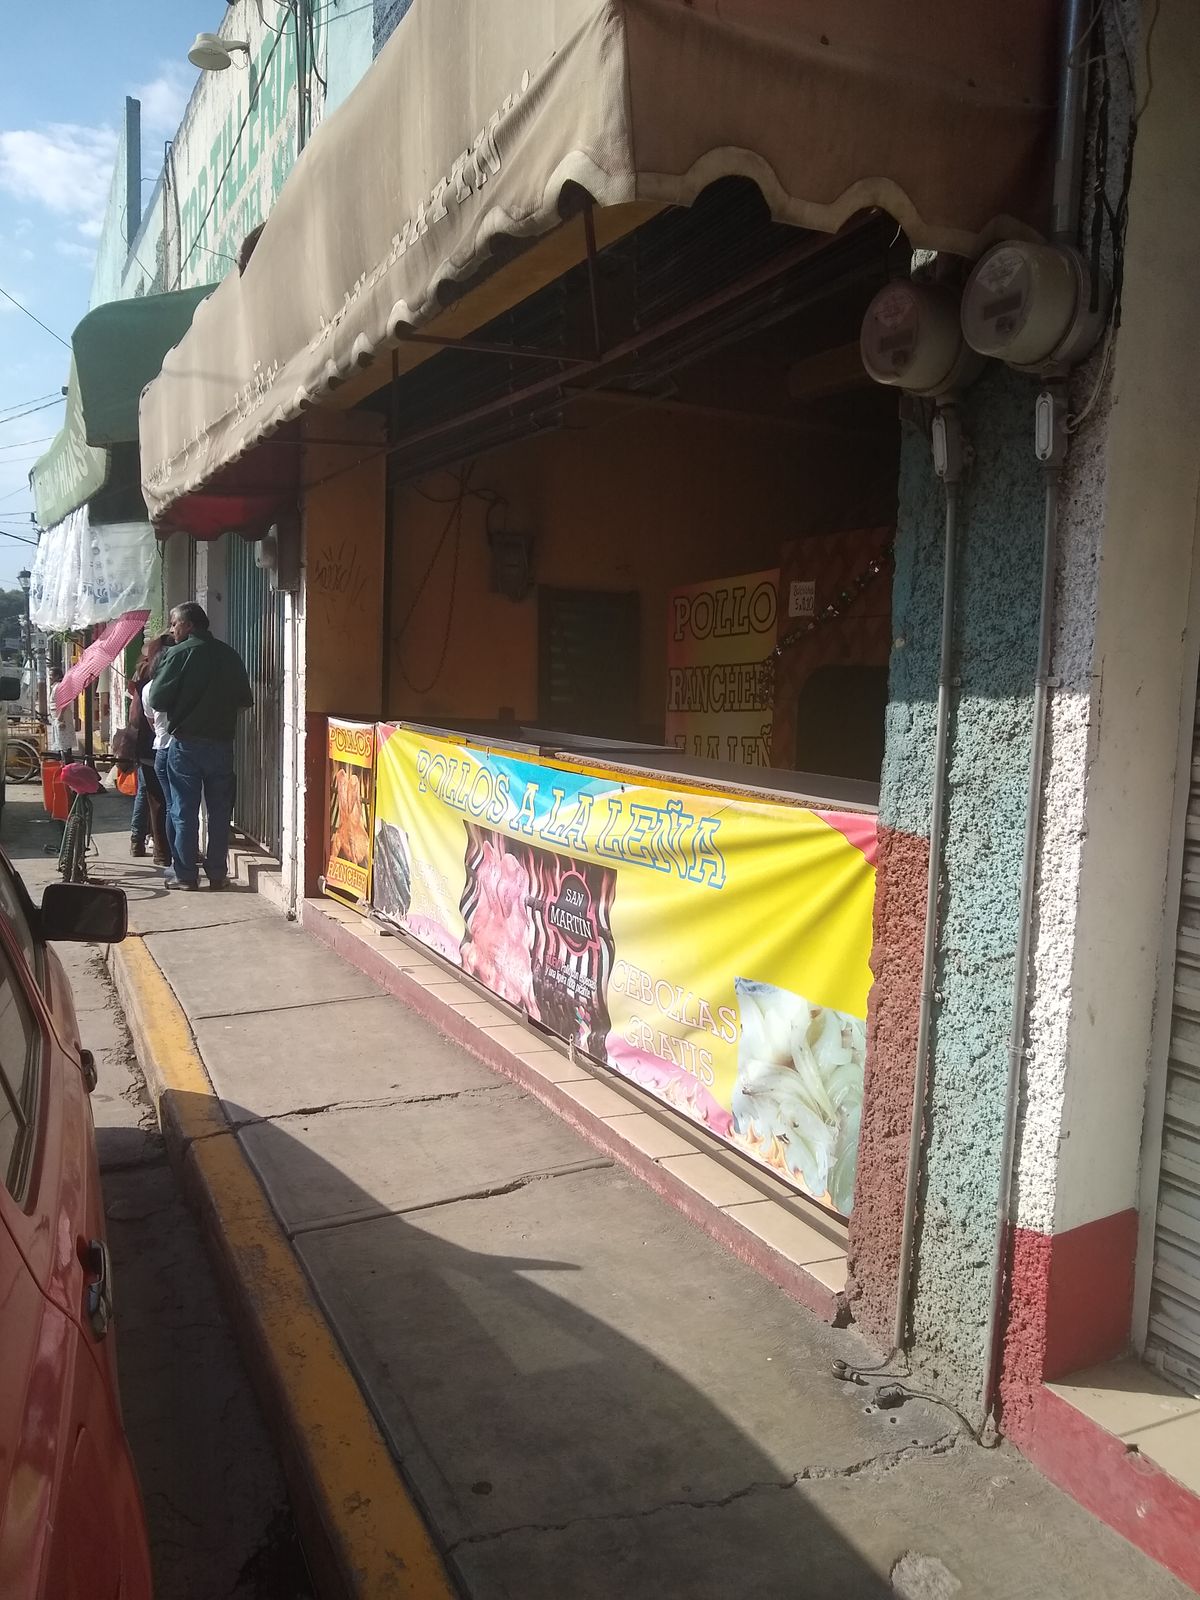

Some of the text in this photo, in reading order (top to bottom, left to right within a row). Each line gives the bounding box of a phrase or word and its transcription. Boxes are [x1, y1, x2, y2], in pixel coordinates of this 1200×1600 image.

[673, 581, 778, 641] POLLO
[329, 725, 372, 759] POLLOS
[416, 749, 727, 890] POLLOS A LA LEÑA
[565, 888, 585, 907] SAN
[610, 959, 738, 1045] CEBOLLAS
[622, 1014, 716, 1087] GRATIS
